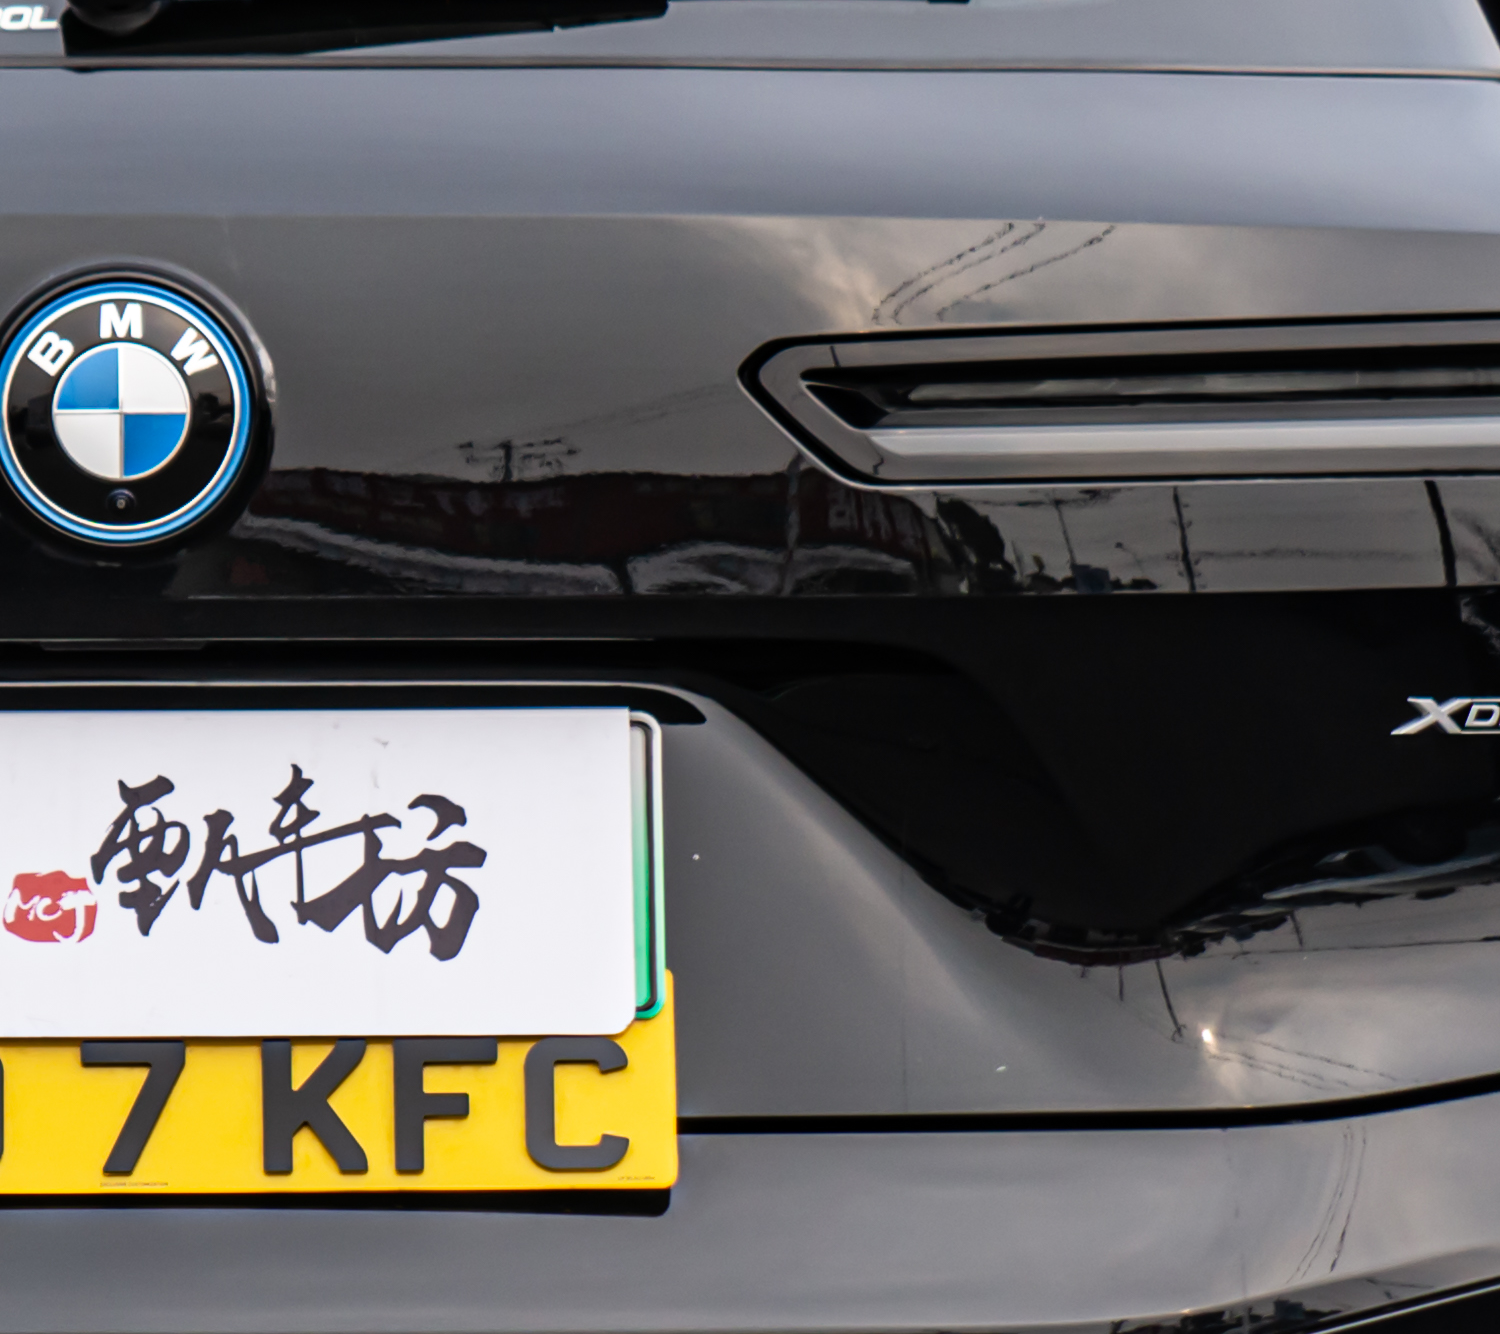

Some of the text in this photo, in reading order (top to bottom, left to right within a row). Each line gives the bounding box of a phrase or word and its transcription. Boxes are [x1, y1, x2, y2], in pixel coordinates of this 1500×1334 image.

[26, 302, 219, 377] BMW
[80, 1040, 187, 1176] 7
[260, 1037, 631, 1175] KFC
